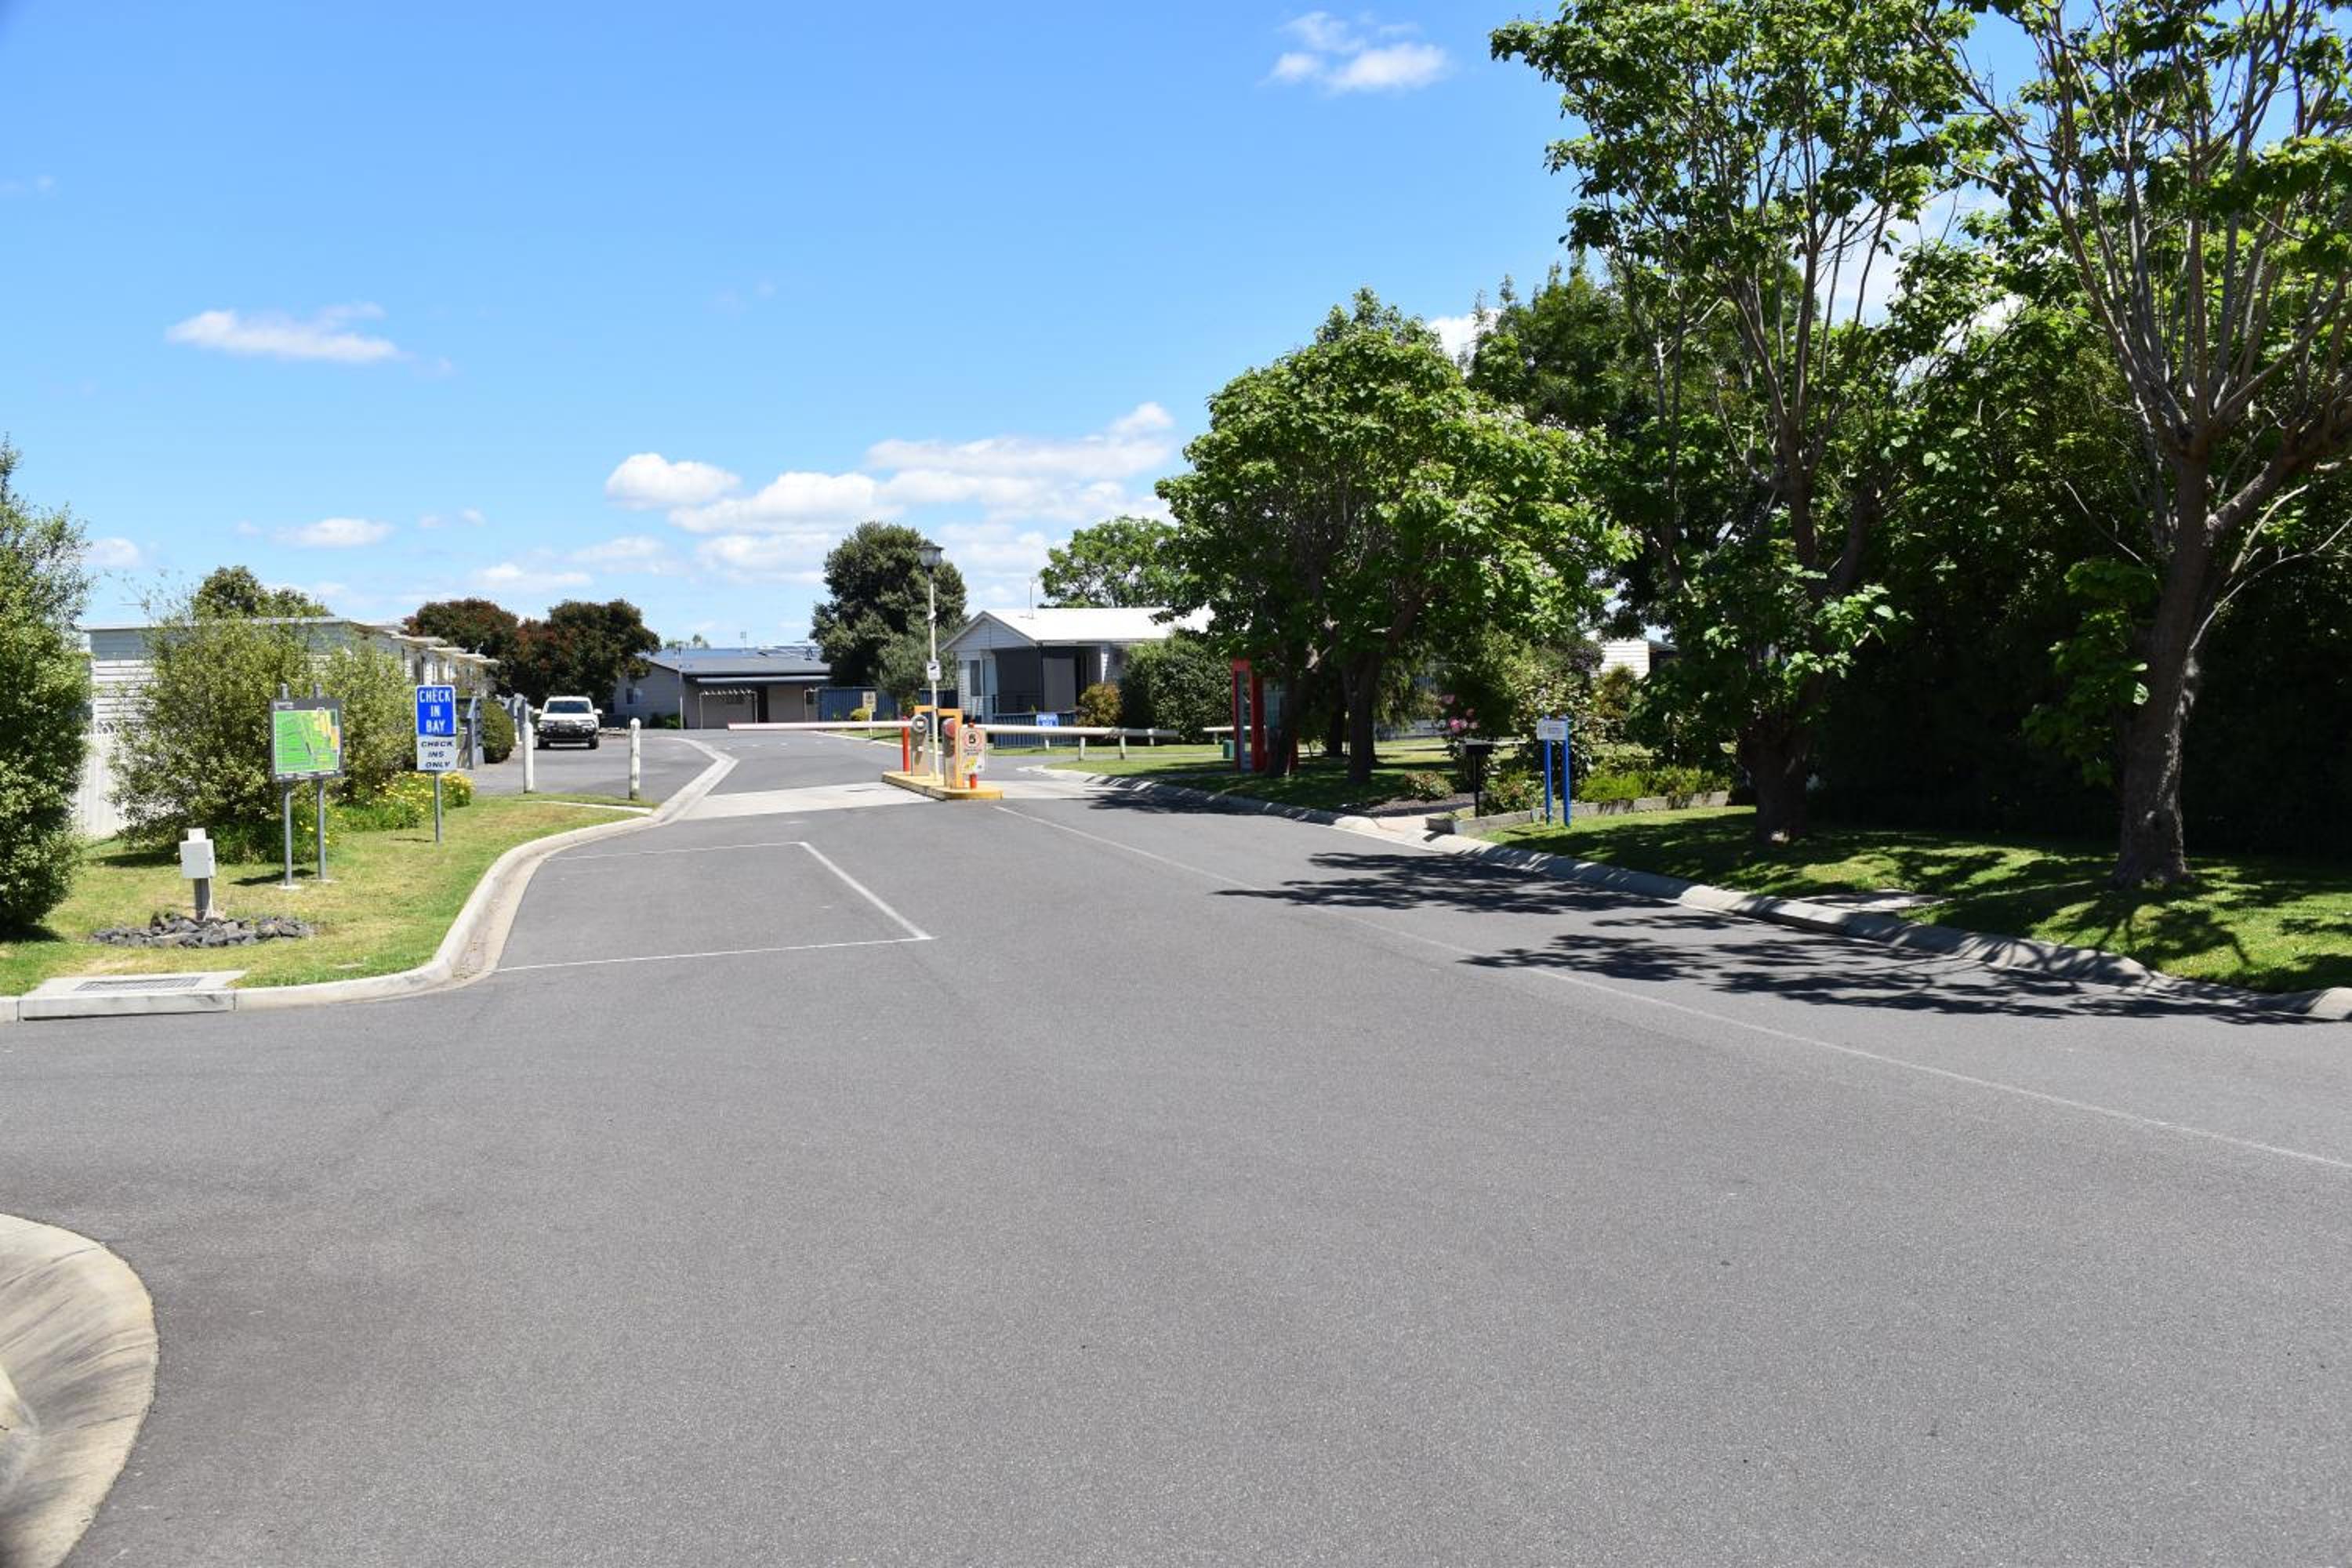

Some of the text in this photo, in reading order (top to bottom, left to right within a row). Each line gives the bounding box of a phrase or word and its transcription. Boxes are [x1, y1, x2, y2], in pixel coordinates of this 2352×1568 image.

[419, 690, 451, 703] CHECK
[430, 705, 441, 717] IN
[426, 719, 446, 734] BAY
